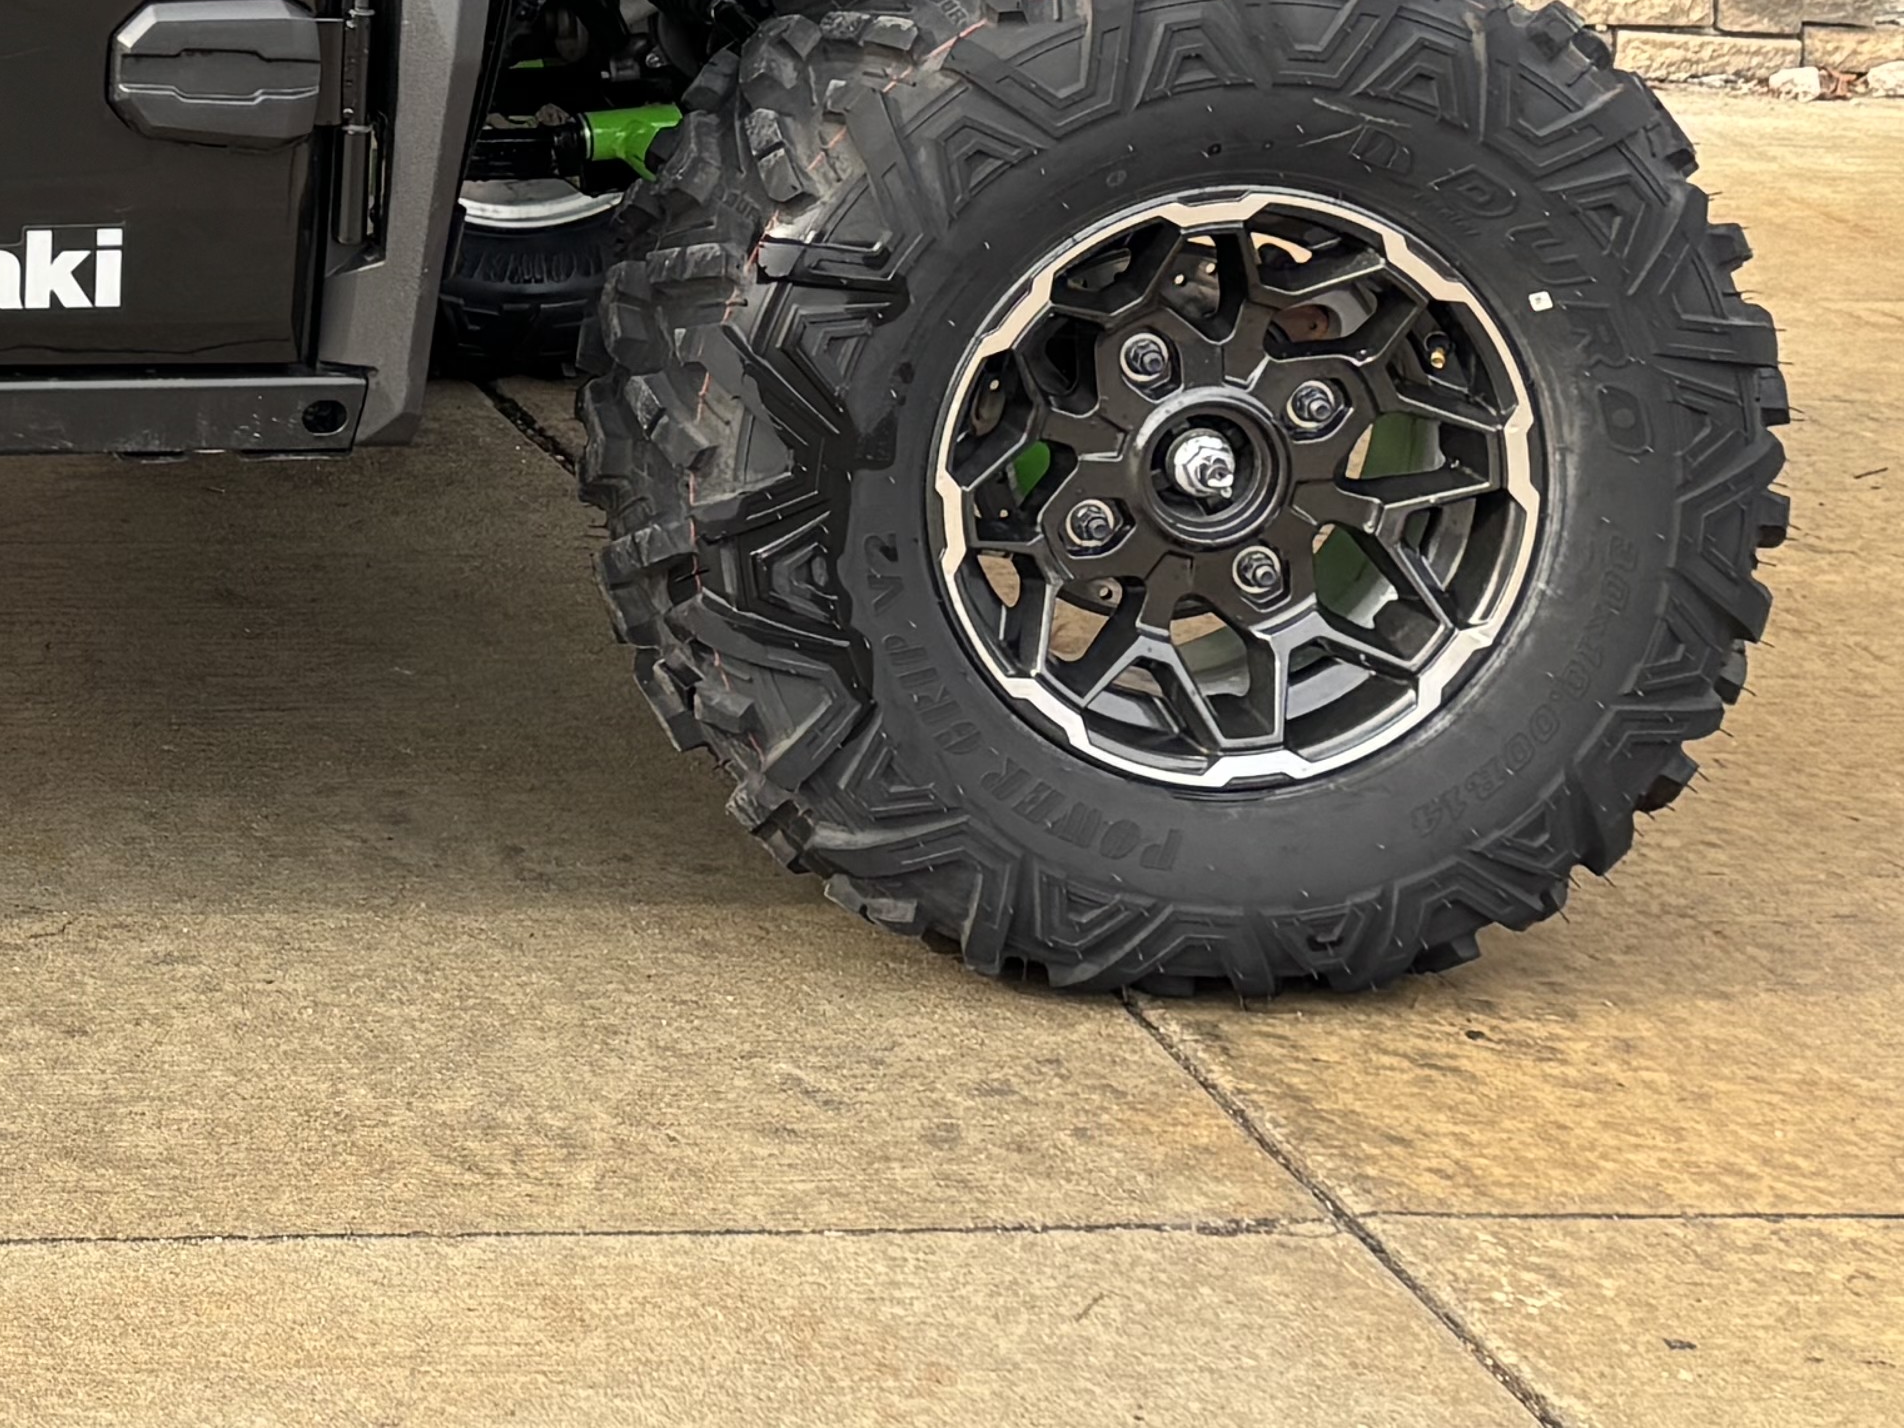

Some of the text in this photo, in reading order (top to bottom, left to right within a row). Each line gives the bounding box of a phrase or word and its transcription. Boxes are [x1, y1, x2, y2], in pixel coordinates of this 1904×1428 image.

[1428, 163, 1655, 455] DURO
[863, 530, 1185, 873] POWER GRIP V2
